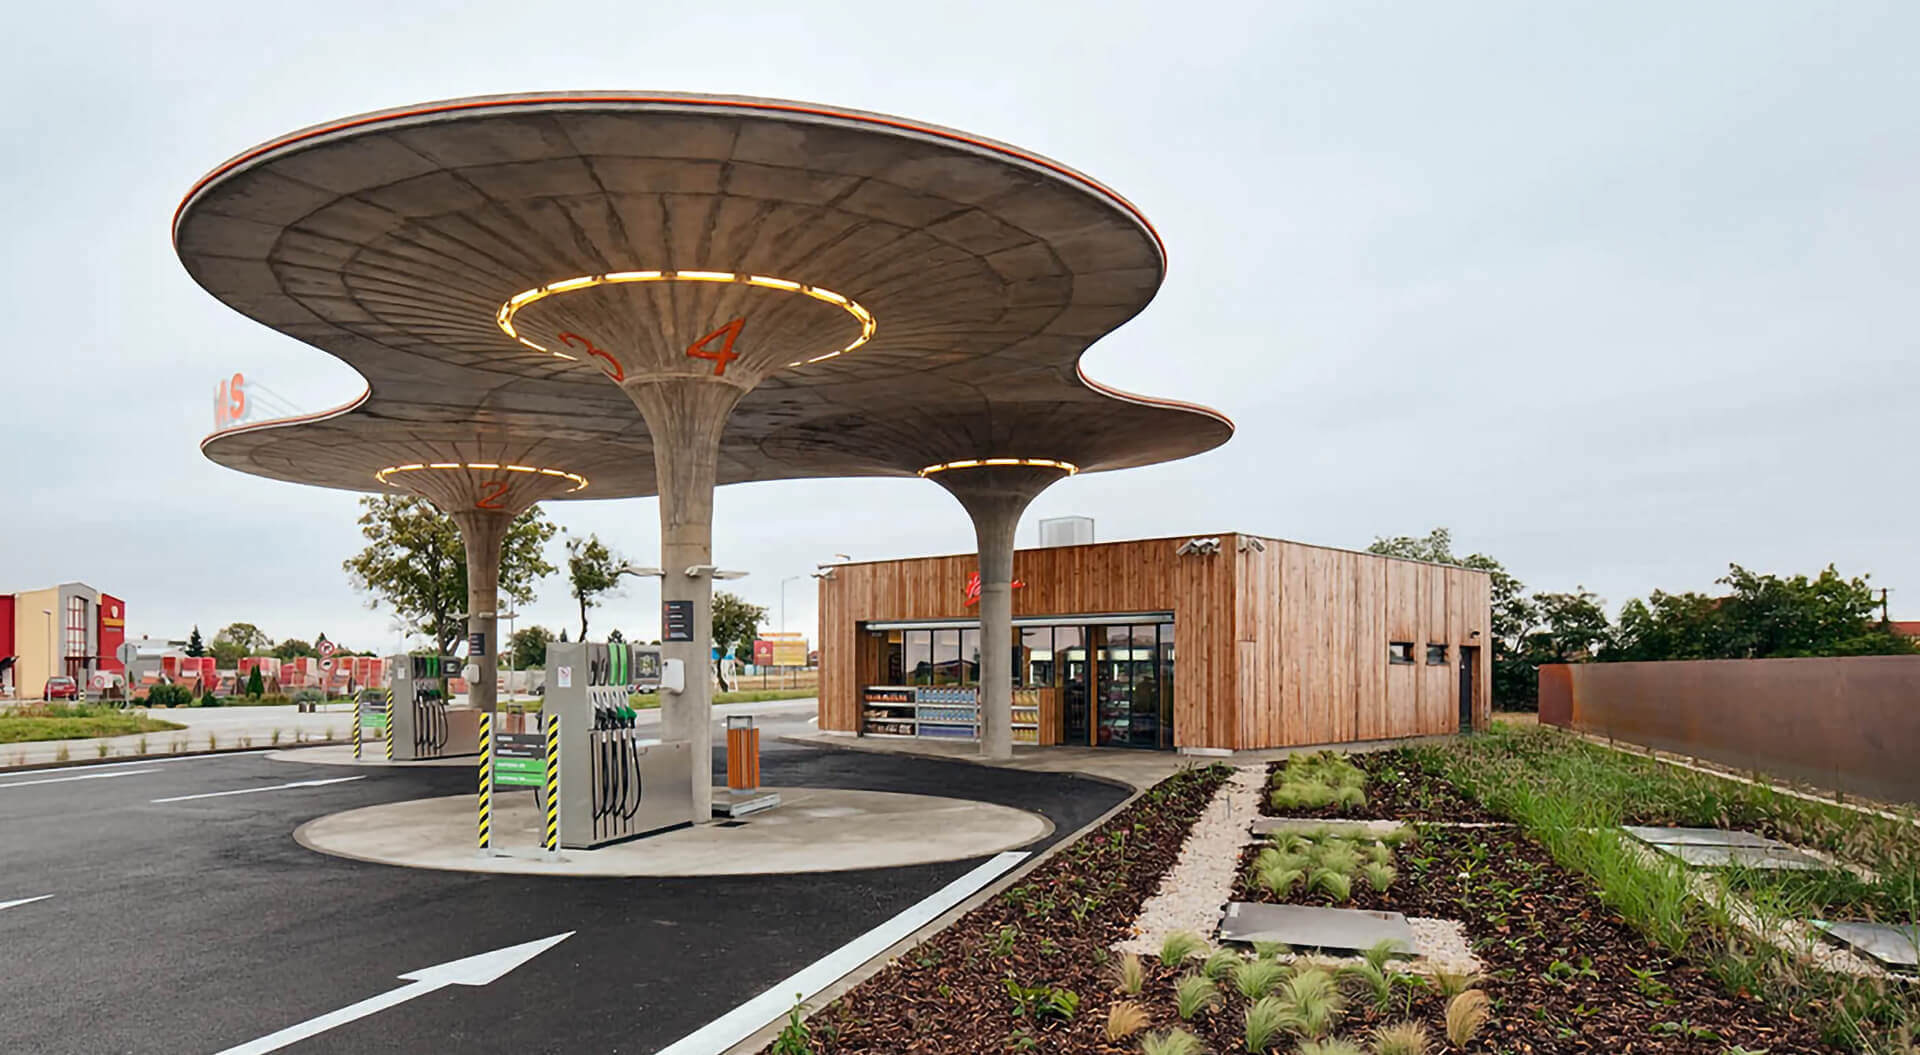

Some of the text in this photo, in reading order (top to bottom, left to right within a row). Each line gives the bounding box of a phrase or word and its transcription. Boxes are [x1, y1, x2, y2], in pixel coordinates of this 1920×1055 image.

[558, 331, 624, 382] 3
[686, 317, 745, 376] 4
[475, 481, 508, 508] 2
